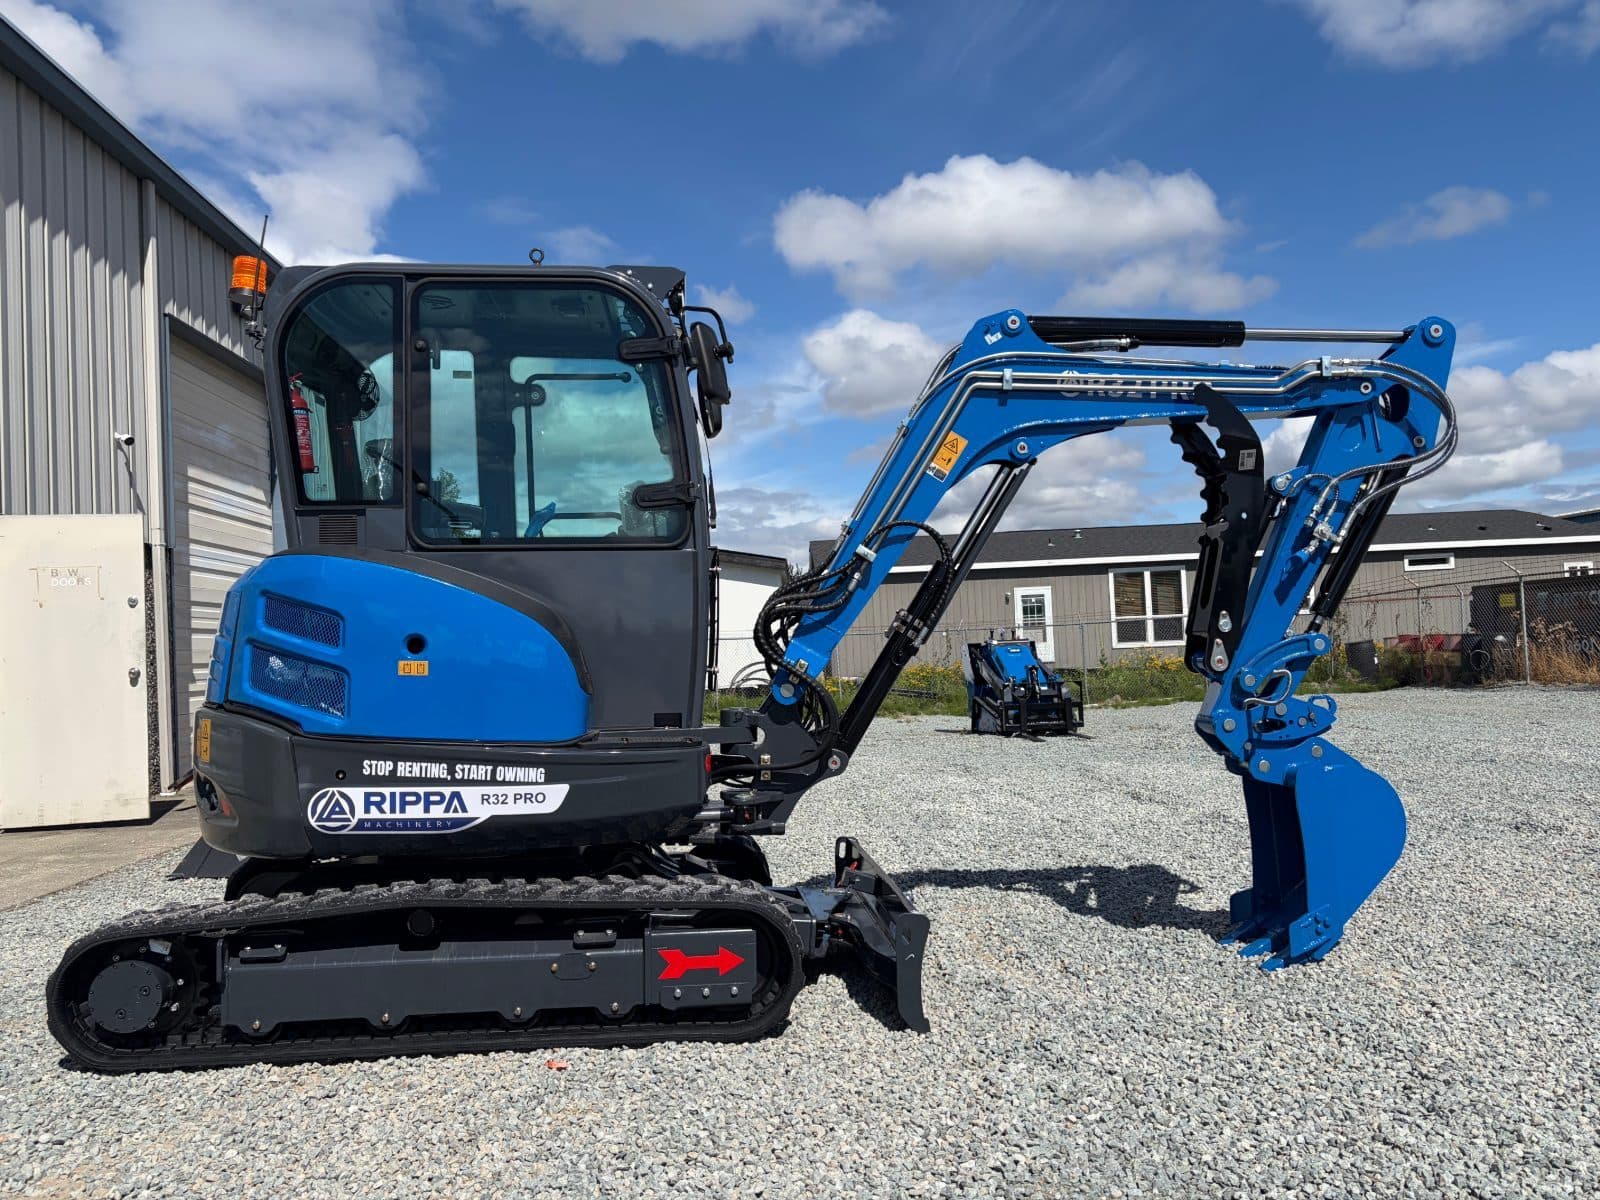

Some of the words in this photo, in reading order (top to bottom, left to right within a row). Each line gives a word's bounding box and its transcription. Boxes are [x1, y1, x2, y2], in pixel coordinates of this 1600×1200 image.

[362, 760, 394, 776] STOP
[397, 761, 451, 781] RENTING,
[454, 764, 493, 782] START
[496, 766, 546, 783] OWNING
[363, 791, 469, 815] RIPPA
[480, 794, 509, 806] R32
[513, 792, 547, 805] PRO
[364, 820, 453, 829] MACHINERY
